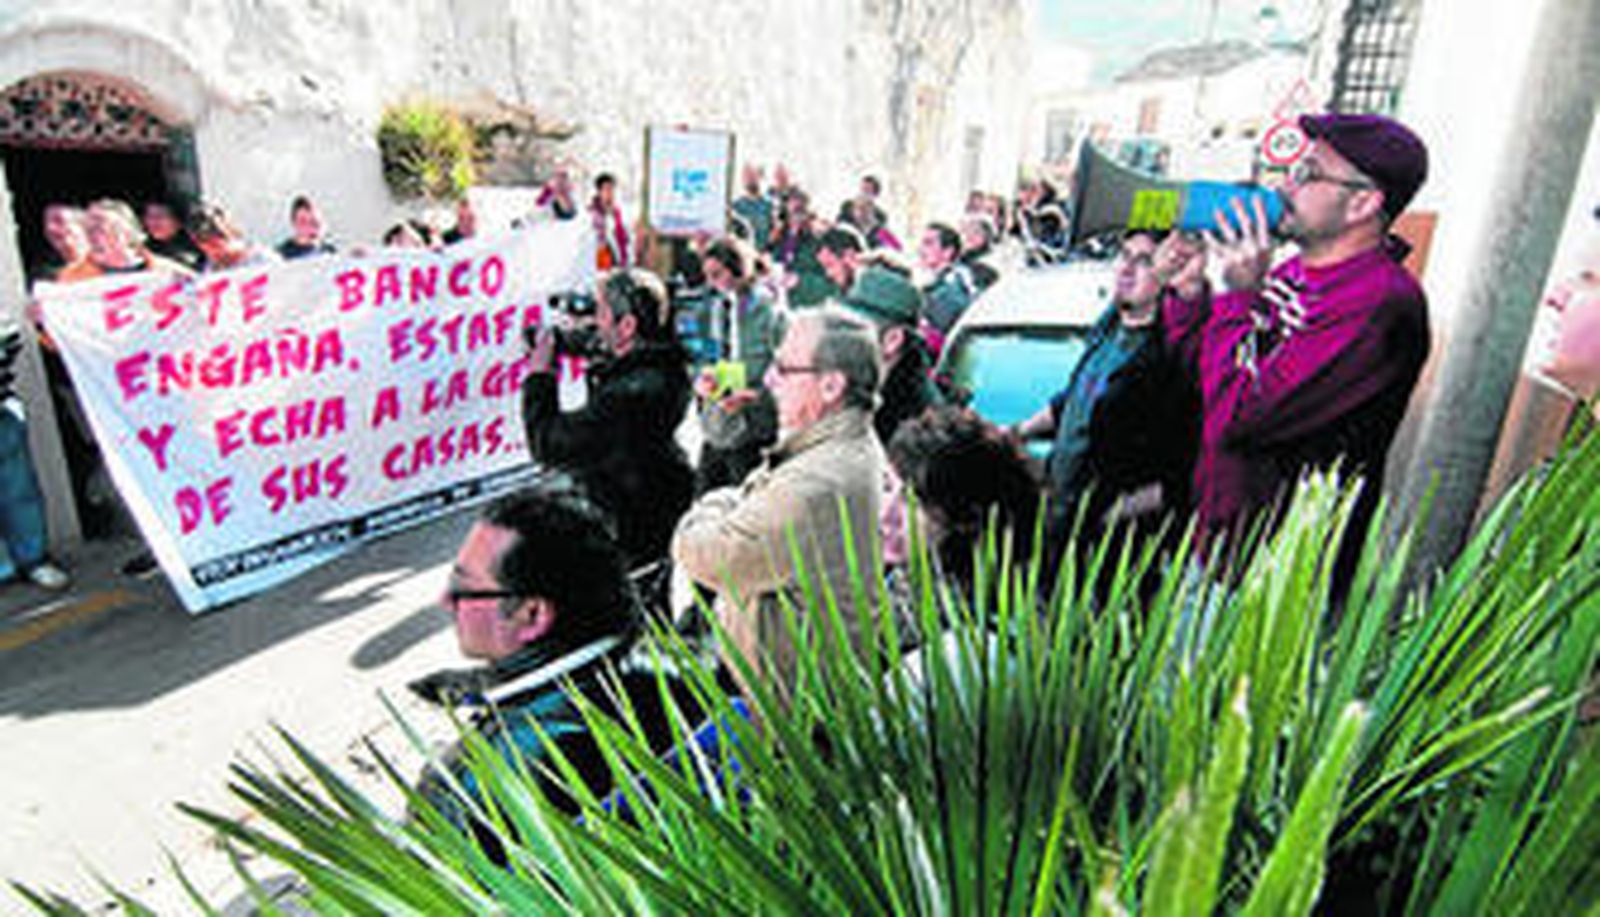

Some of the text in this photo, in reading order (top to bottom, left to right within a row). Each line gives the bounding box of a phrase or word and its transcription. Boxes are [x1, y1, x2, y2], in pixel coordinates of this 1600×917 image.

[103, 254, 506, 331] ESTE BANCO
[114, 327, 362, 402] ENGAÑA.
[136, 422, 176, 472] Y
[213, 395, 347, 459] ECHA
[370, 386, 403, 431] A
[420, 369, 470, 416] LA
[173, 475, 233, 537] DE
[260, 453, 348, 514] SUS
